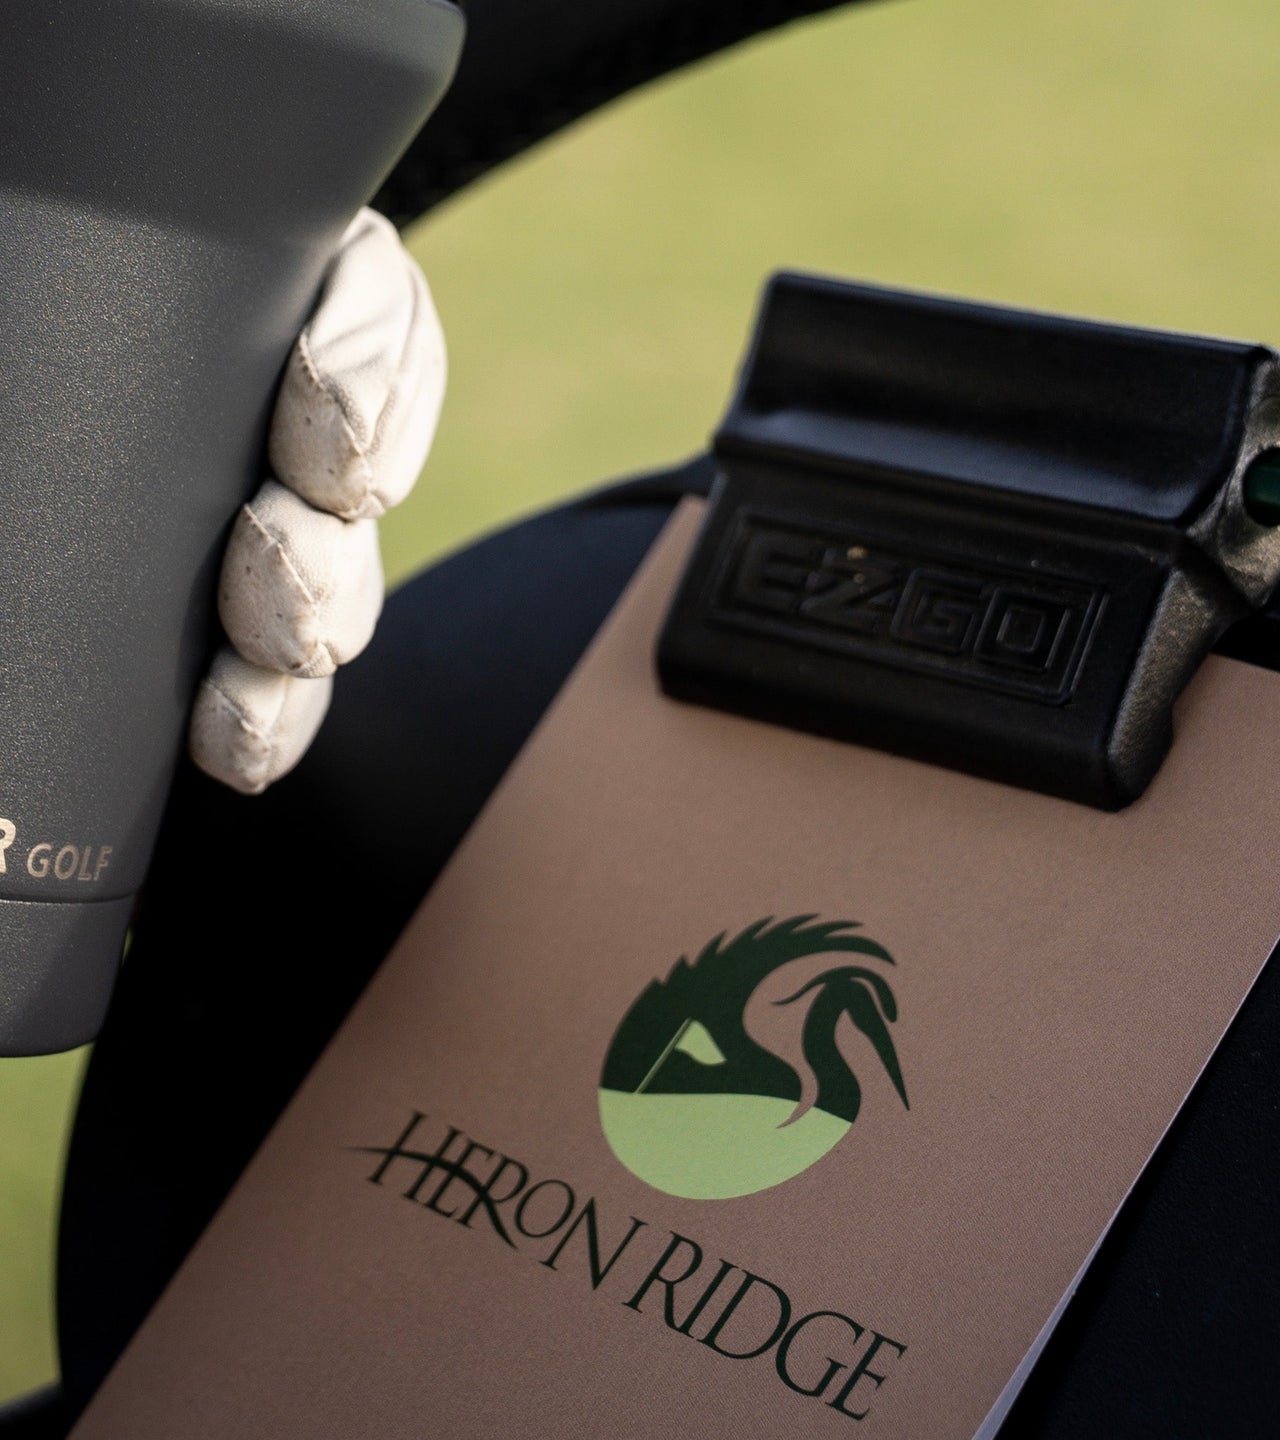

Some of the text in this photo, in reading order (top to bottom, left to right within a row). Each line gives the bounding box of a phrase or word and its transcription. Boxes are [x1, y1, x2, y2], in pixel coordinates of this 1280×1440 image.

[27, 842, 114, 882] GOLF
[342, 1109, 908, 1422] HERON RIDGE
